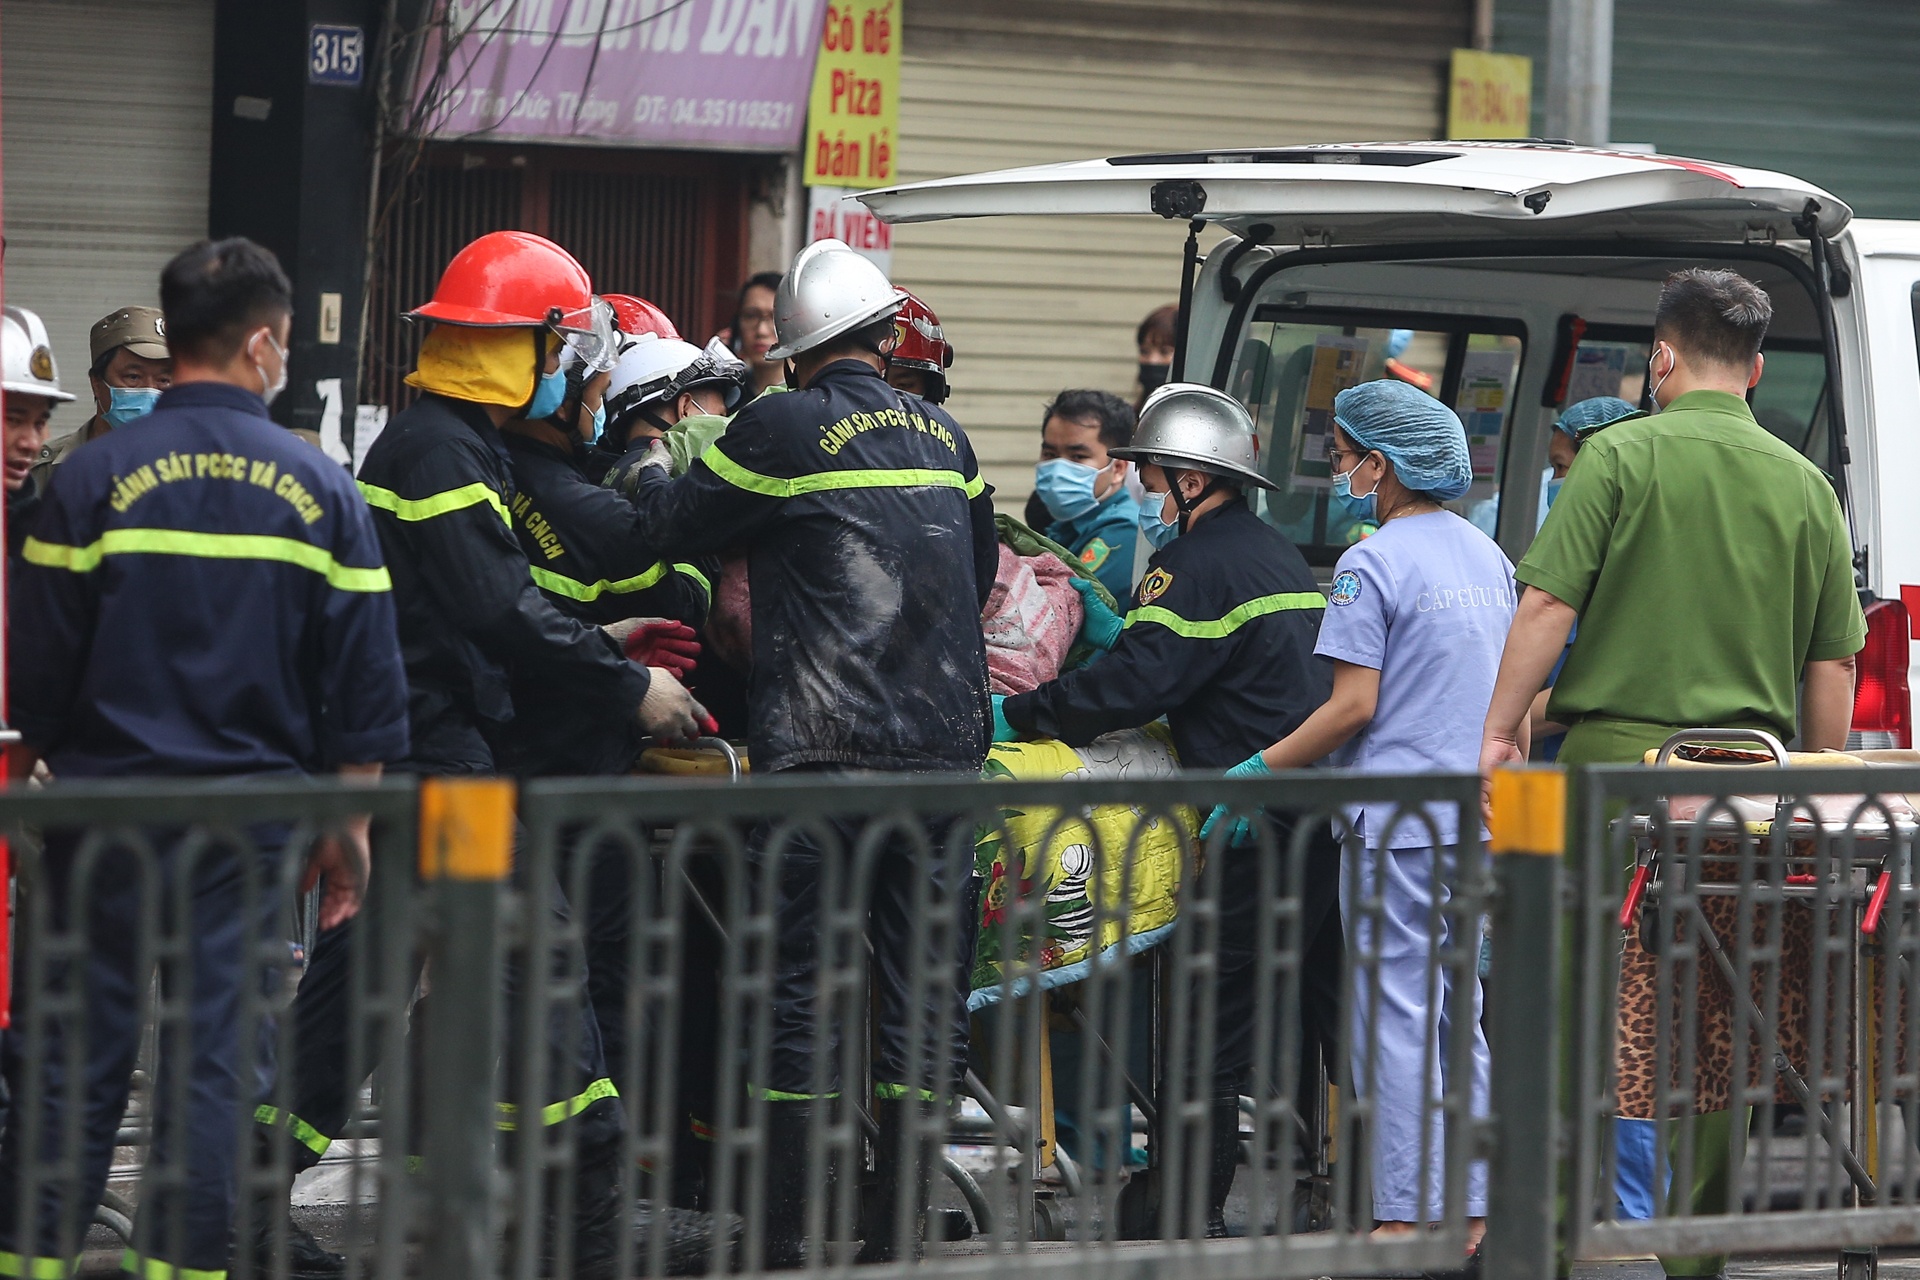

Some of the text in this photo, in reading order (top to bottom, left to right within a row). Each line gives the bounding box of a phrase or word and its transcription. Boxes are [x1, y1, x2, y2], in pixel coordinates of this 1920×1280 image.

[823, 7, 854, 52] Có
[313, 33, 358, 75] 315
[830, 68, 882, 116] Piza
[815, 127, 890, 178] bán lẻ
[819, 417, 857, 456] CẢNH
[110, 451, 324, 525] CẢNH SÁT PCCC VÀ CNCH
[512, 491, 565, 560] VÀ CNCH
[1416, 582, 1454, 612] CẤP
[1458, 583, 1491, 608] CỨU
